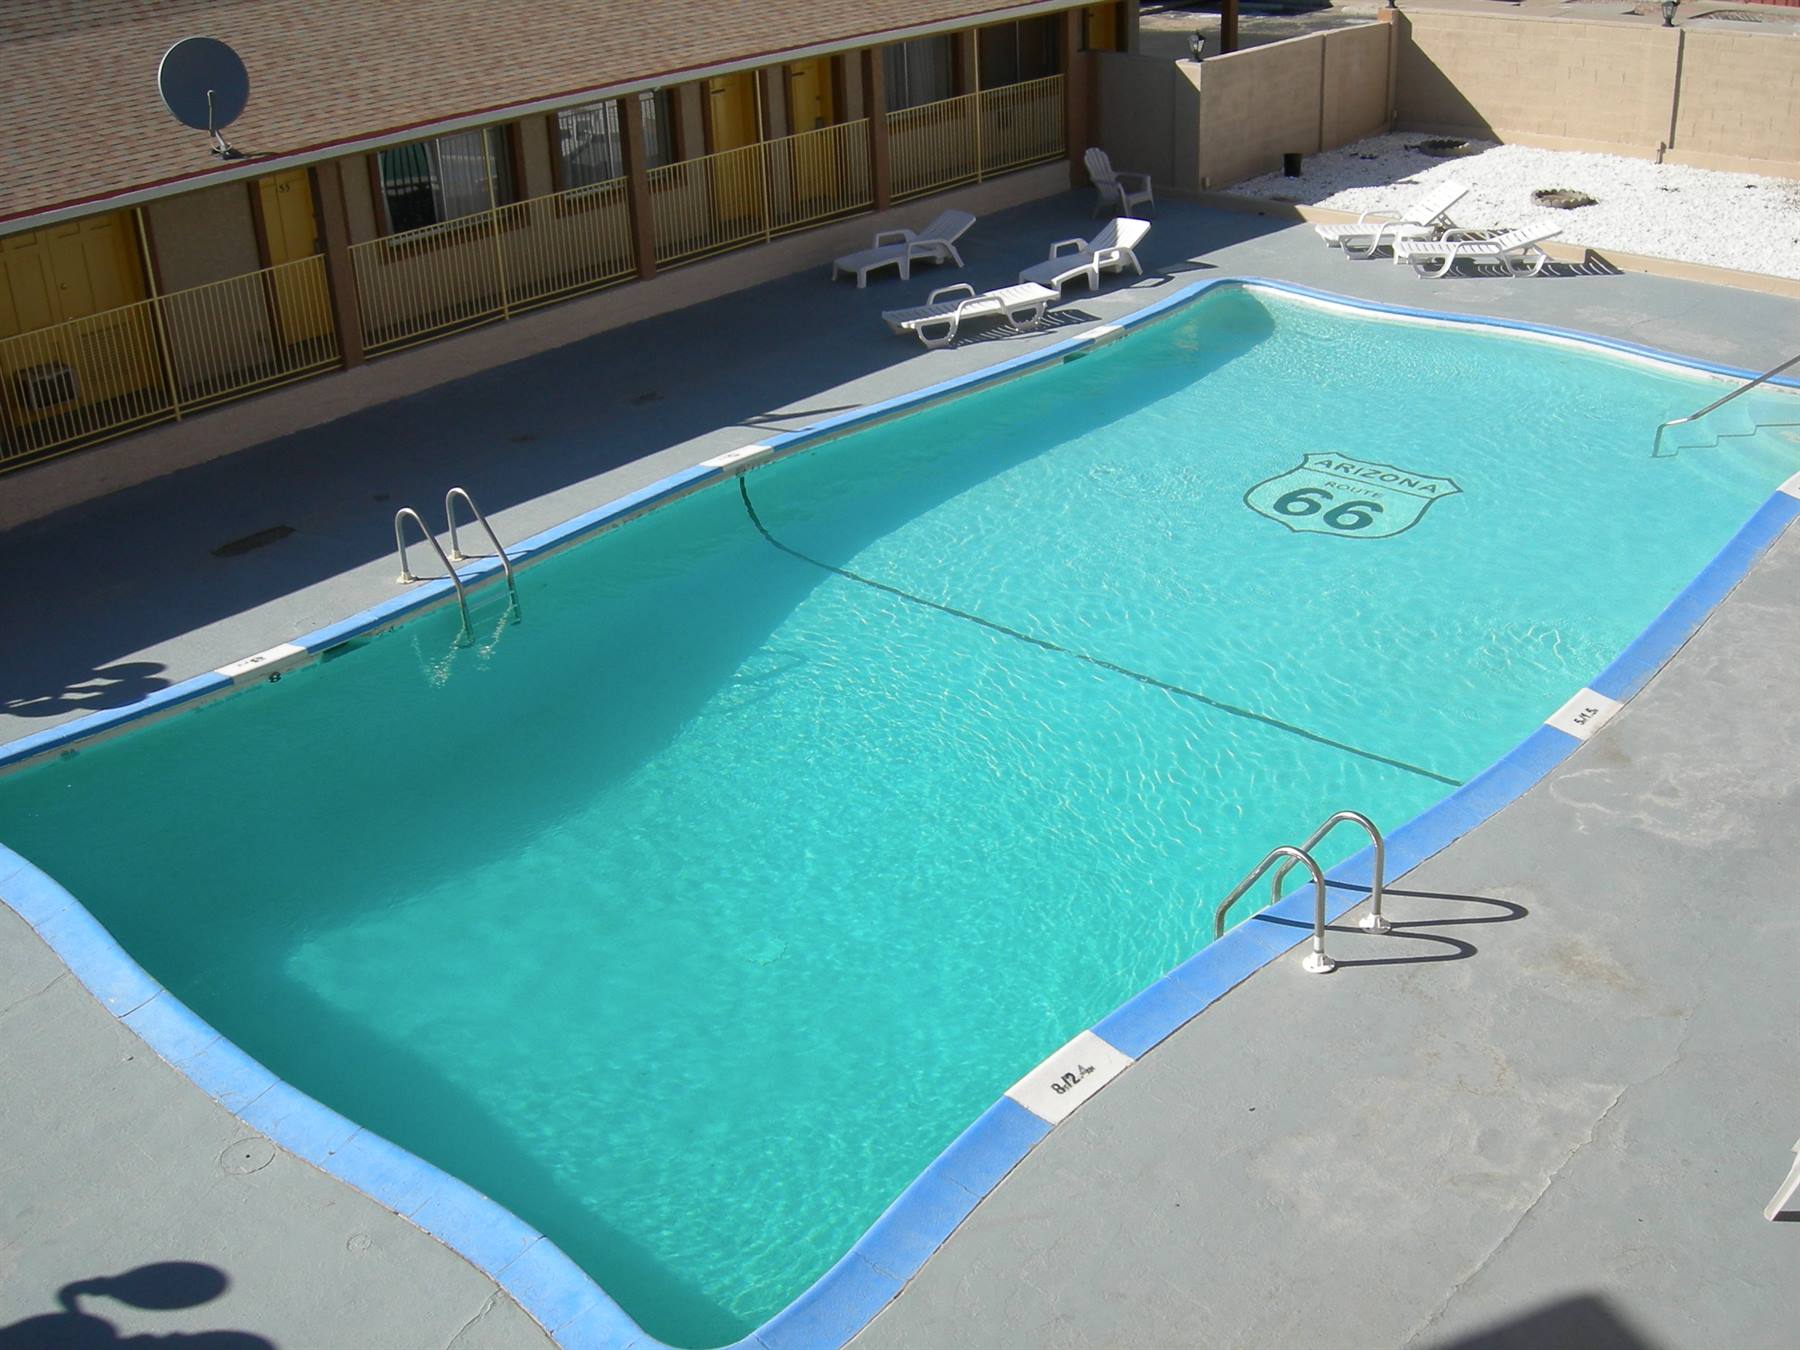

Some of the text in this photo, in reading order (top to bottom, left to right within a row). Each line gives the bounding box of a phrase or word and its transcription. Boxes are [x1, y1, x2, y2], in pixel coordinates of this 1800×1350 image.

[1314, 458, 1438, 494] ARIZONA
[1324, 480, 1387, 499] ROUTE
[1272, 487, 1385, 531] 66
